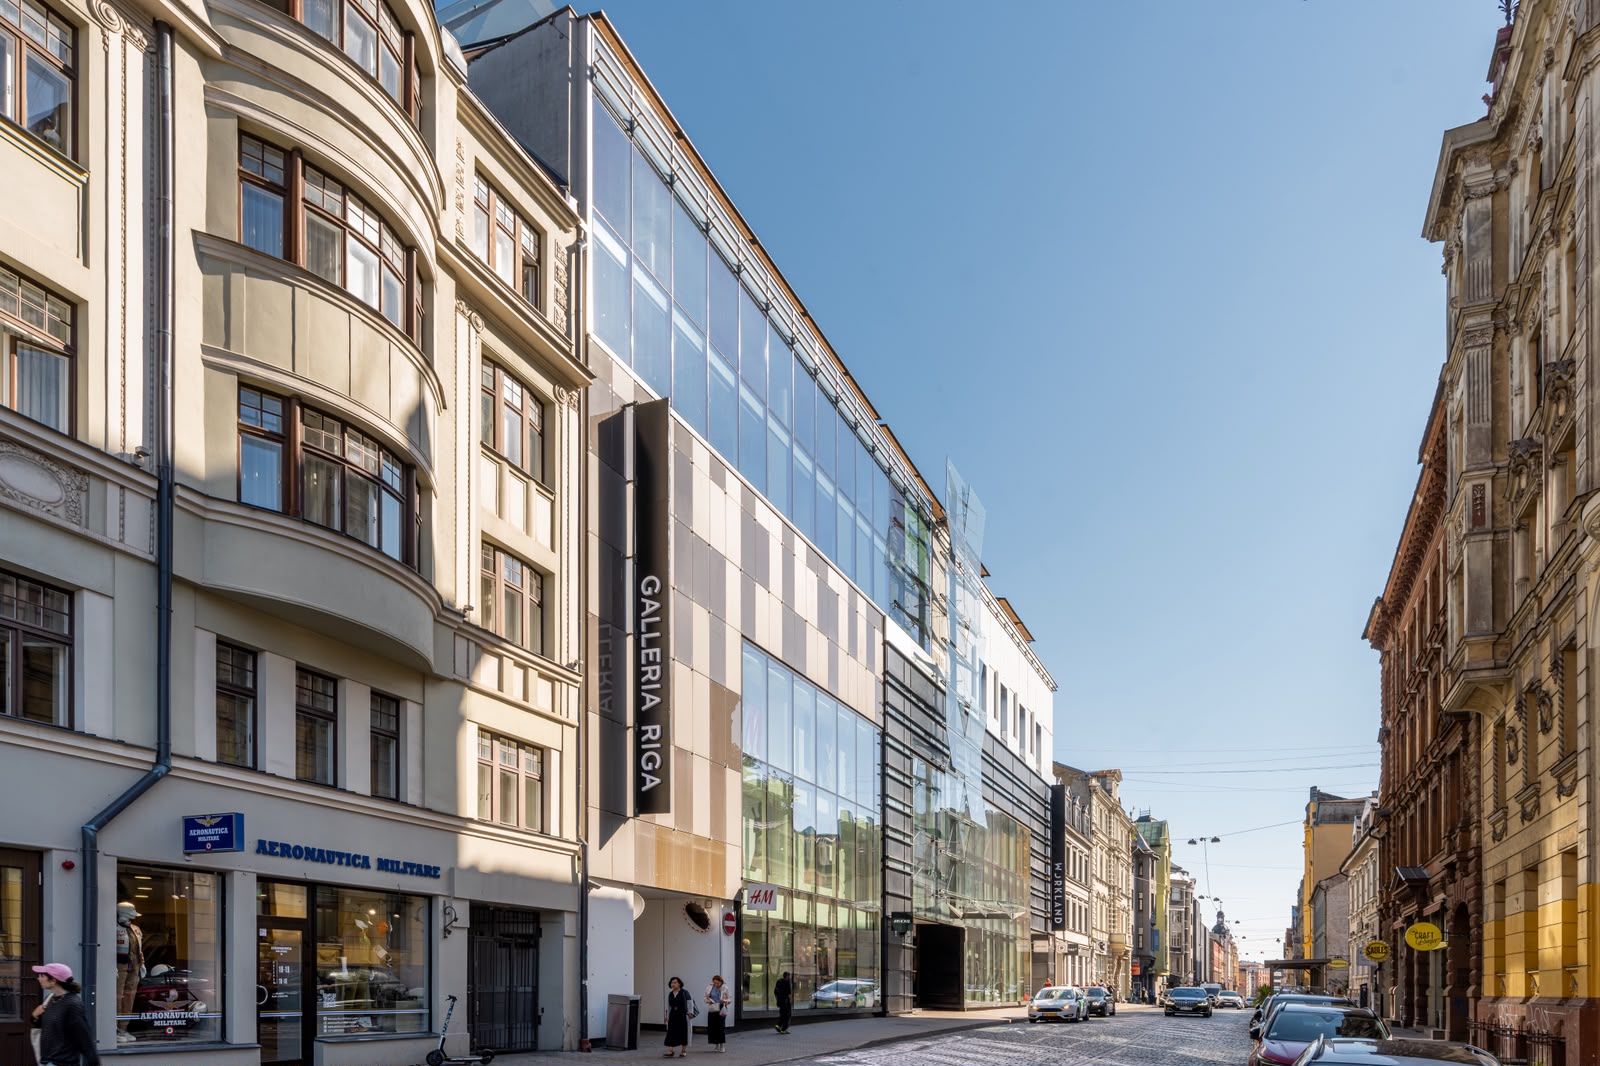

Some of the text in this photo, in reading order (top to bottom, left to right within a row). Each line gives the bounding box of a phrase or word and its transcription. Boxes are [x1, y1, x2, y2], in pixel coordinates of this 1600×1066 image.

[641, 575, 663, 792] GALLERIA RIGA
[189, 827, 229, 836] AERONAUTICA
[255, 839, 441, 879] AERONAUTICA MILITARE
[1414, 931, 1434, 940] CRAFT
[140, 1011, 199, 1020] AERONAUTICA
[153, 1019, 187, 1027] MILITARE
